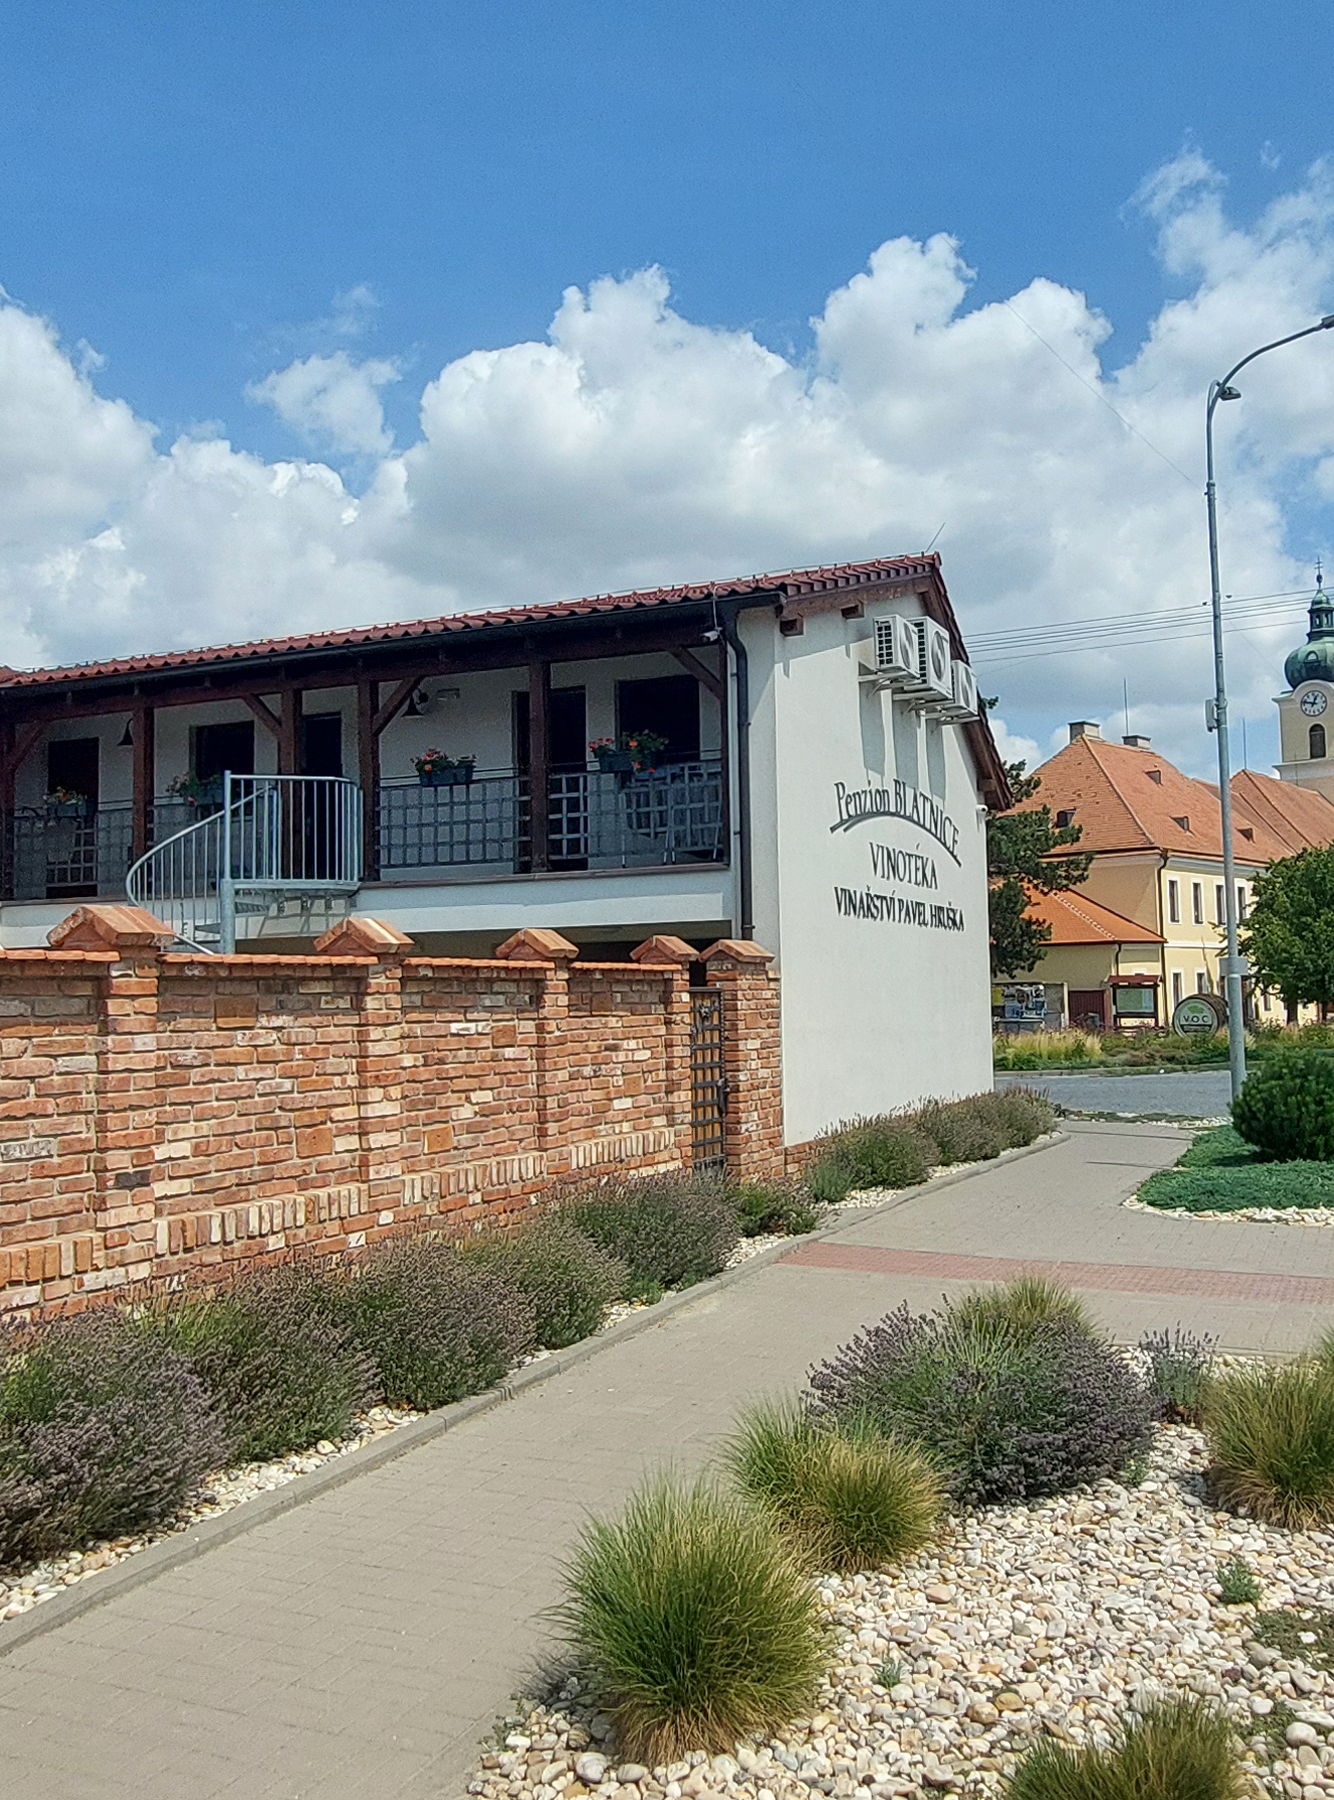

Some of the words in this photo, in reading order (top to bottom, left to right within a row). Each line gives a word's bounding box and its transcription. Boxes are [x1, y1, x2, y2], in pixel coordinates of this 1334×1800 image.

[834, 780, 890, 821] Penzion
[893, 778, 959, 857] BLATNICE
[869, 842, 938, 890] VINOTÉKA
[833, 884, 896, 922] VINAŘSTVÍ
[897, 898, 929, 927] PAVEL
[929, 901, 965, 932] HRUŠKA
